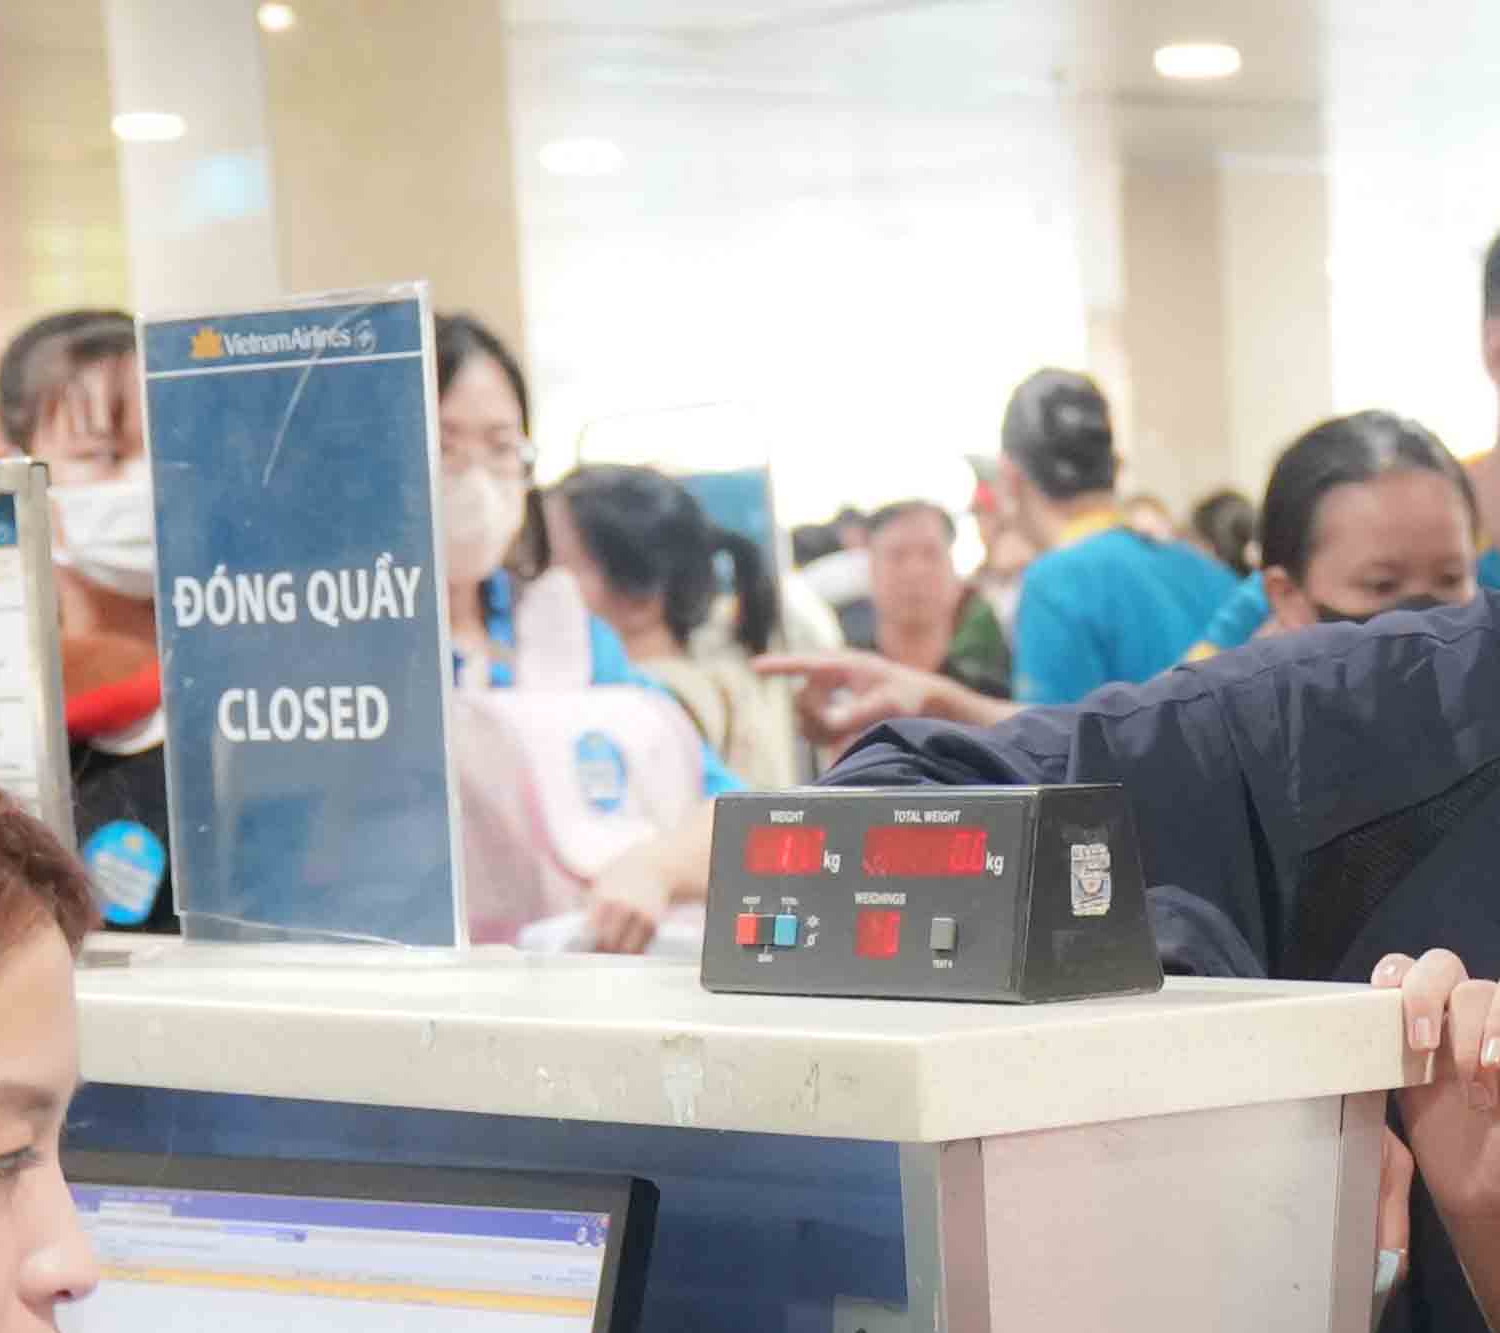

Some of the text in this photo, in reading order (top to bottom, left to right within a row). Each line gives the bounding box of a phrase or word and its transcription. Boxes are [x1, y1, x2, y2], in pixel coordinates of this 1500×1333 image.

[171, 551, 421, 628] ĐÓNG QUẦY
[217, 685, 389, 742] CLOSED
[769, 810, 804, 823] WEIGHT
[893, 809, 961, 823] TOTAL WEIGHT
[823, 850, 841, 873] kg
[986, 851, 1004, 876] kg
